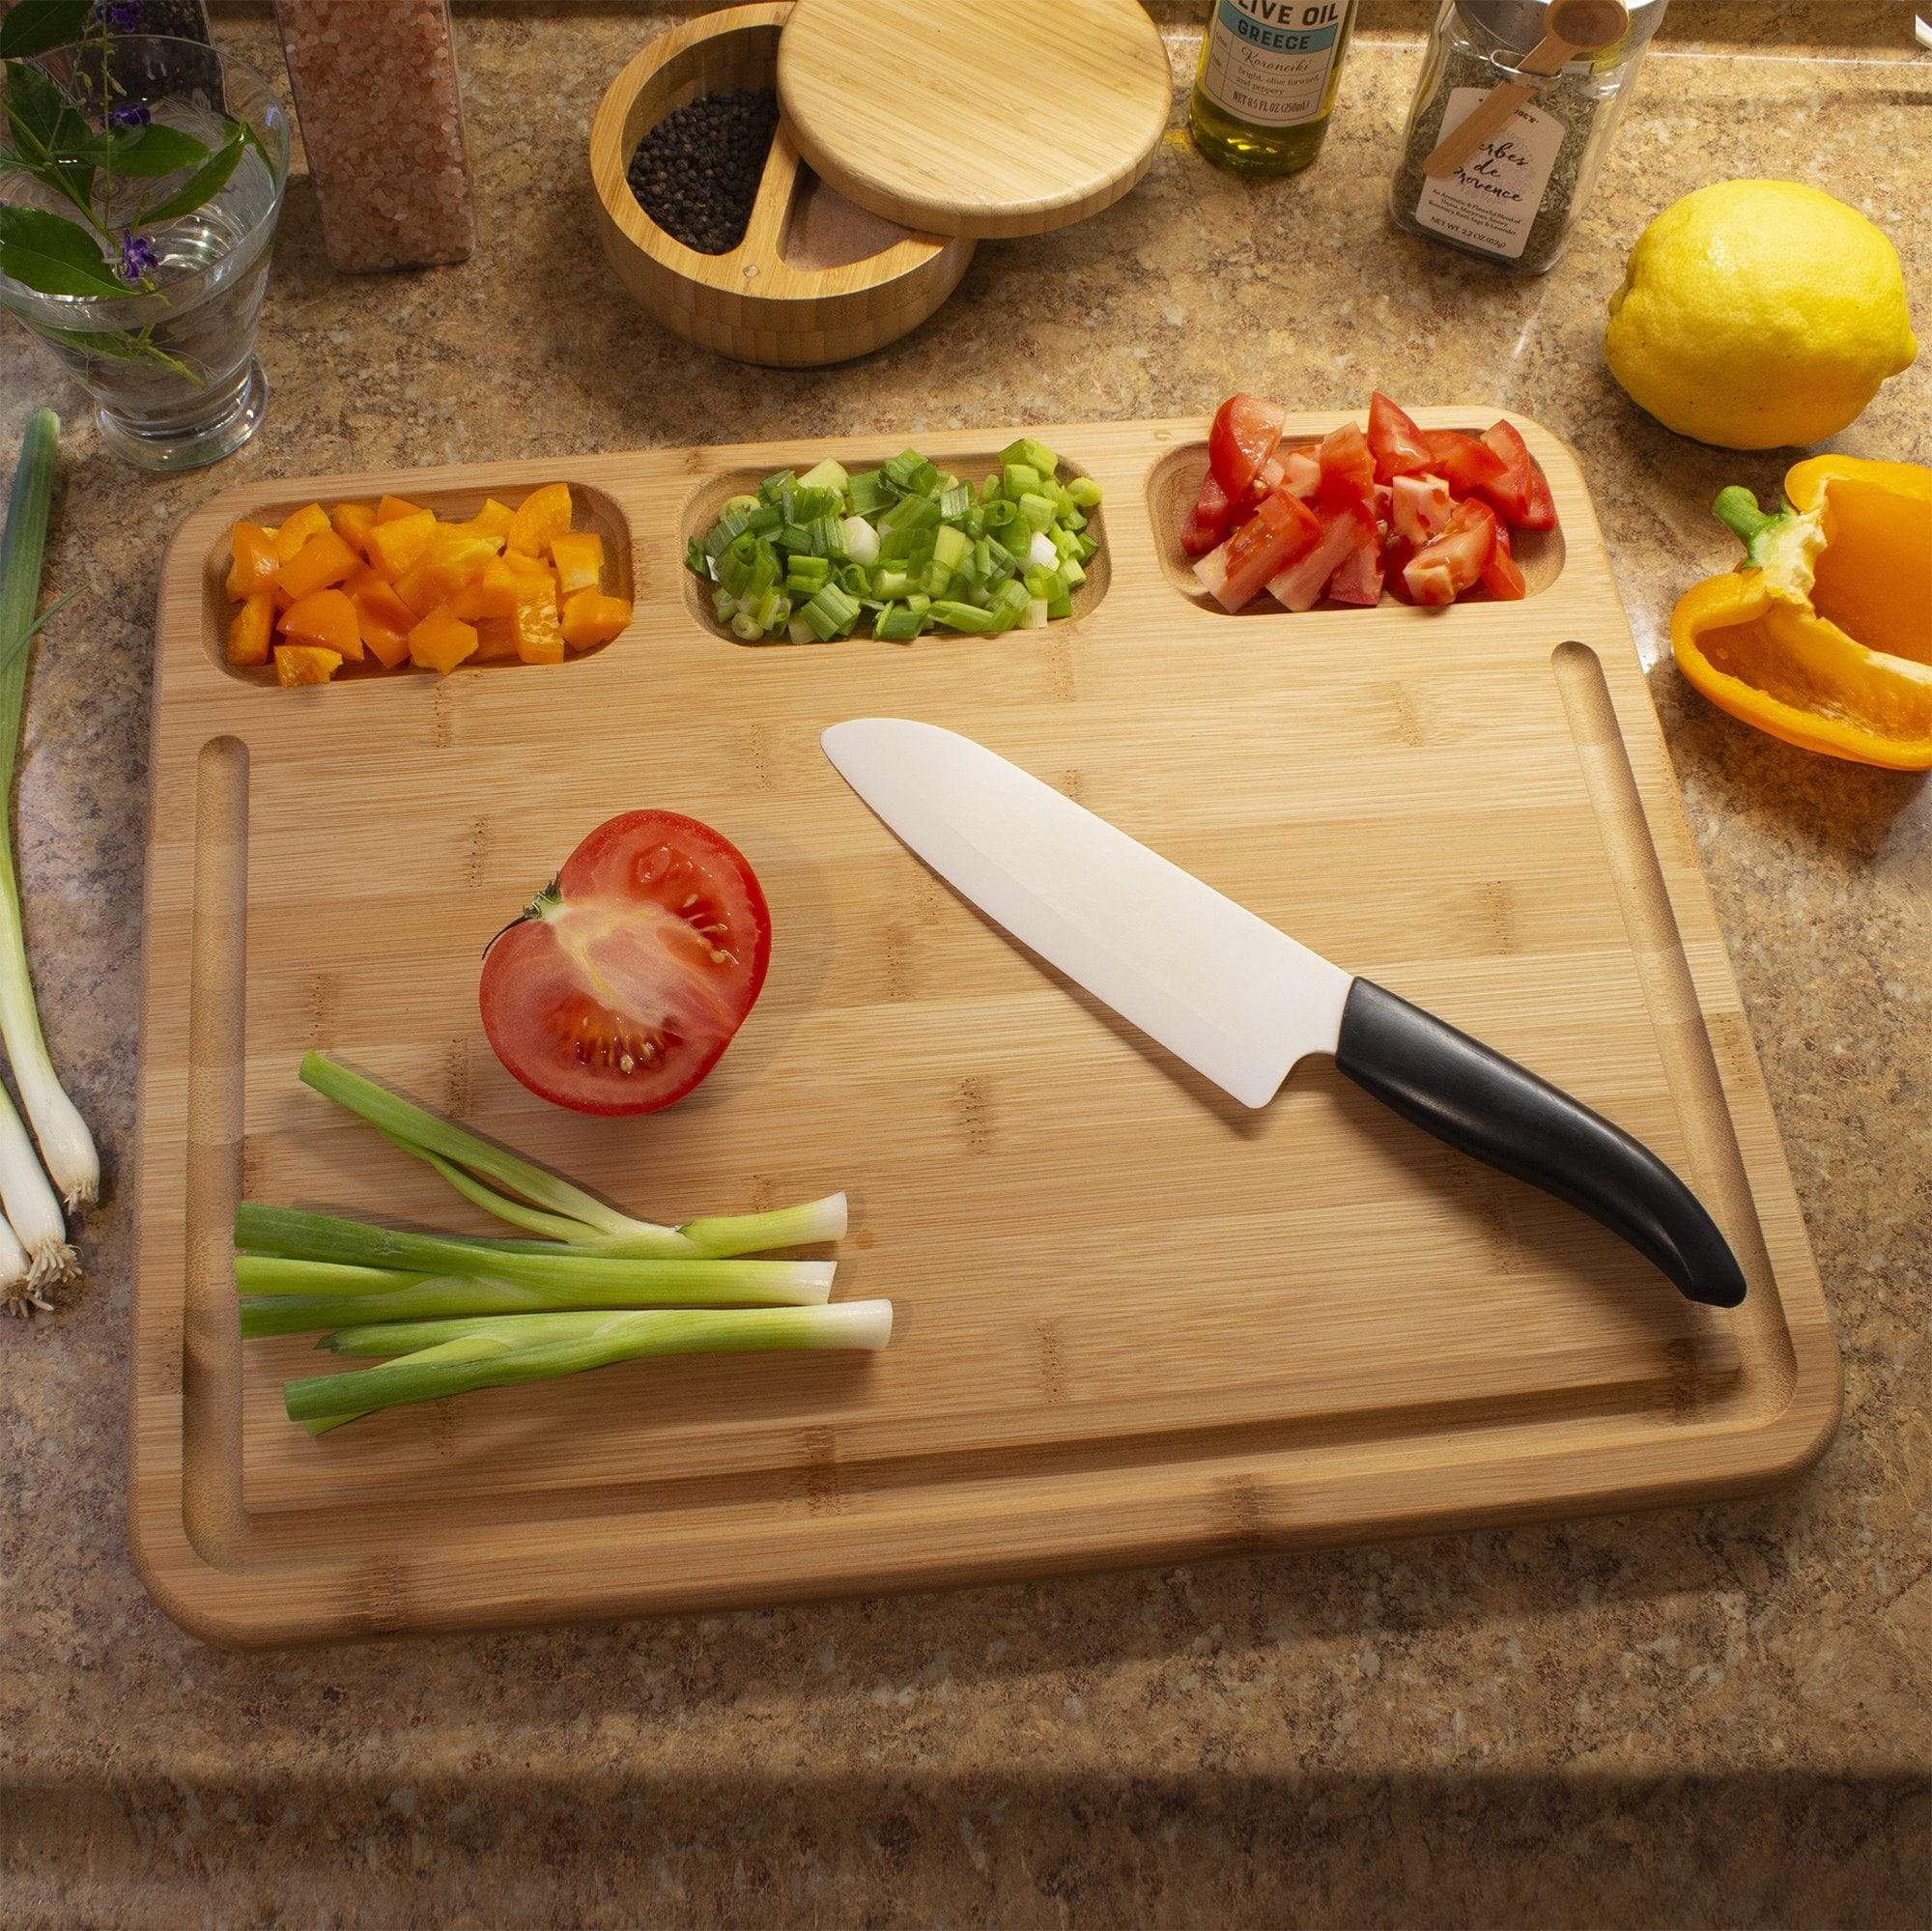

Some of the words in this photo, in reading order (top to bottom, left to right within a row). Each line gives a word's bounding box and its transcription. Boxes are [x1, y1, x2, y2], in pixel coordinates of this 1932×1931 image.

[1302, 3, 1338, 26] OIL
[1237, 19, 1311, 49] GREECE
[1241, 47, 1313, 71] Koroneiki
[1236, 77, 1251, 86] and
[1252, 83, 1285, 96] peppery
[1266, 77, 1285, 86] olive
[1233, 91, 1247, 105] NET
[1478, 142, 1528, 166] erbes
[1474, 158, 1501, 178] de
[1431, 216, 1445, 226] NET
